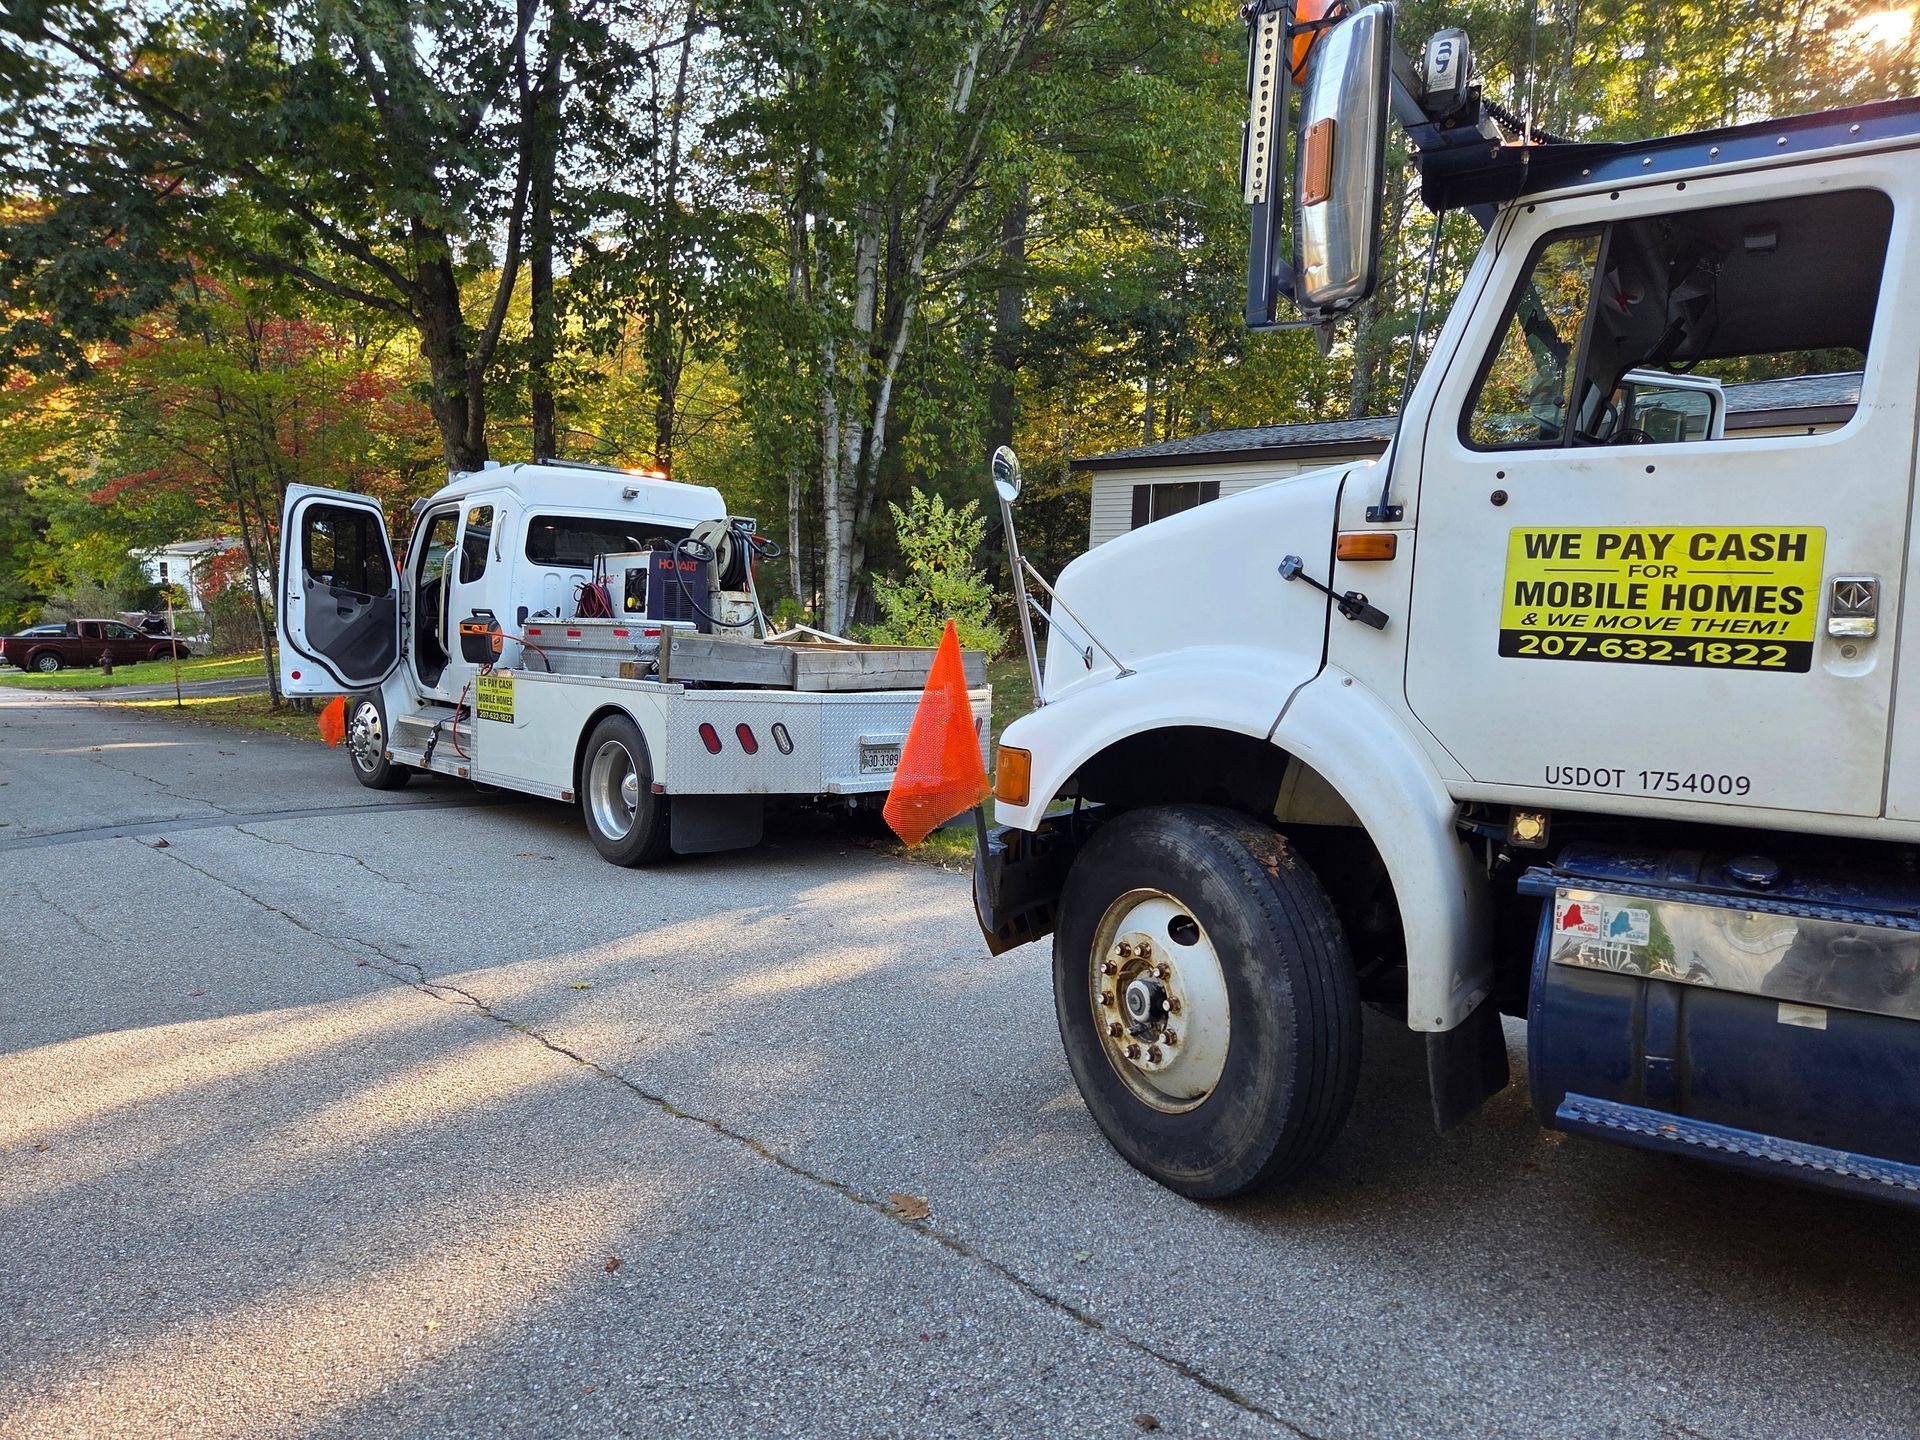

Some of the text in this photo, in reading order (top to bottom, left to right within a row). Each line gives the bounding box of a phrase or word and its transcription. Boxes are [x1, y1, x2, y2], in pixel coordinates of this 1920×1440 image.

[1524, 533, 1808, 562] WE PAY CASH
[1628, 564, 1679, 579] FOR
[1514, 581, 1805, 615] MOBILE HOMES
[1520, 613, 1790, 635] & WE MOVE THEM!
[1517, 634, 1788, 667] 207-632-1822
[479, 678, 513, 689] WE PAY CASH
[478, 693, 496, 703] MOBILE
[496, 695, 513, 706] HOMES
[1545, 766, 1751, 795] USDOT 1754009
